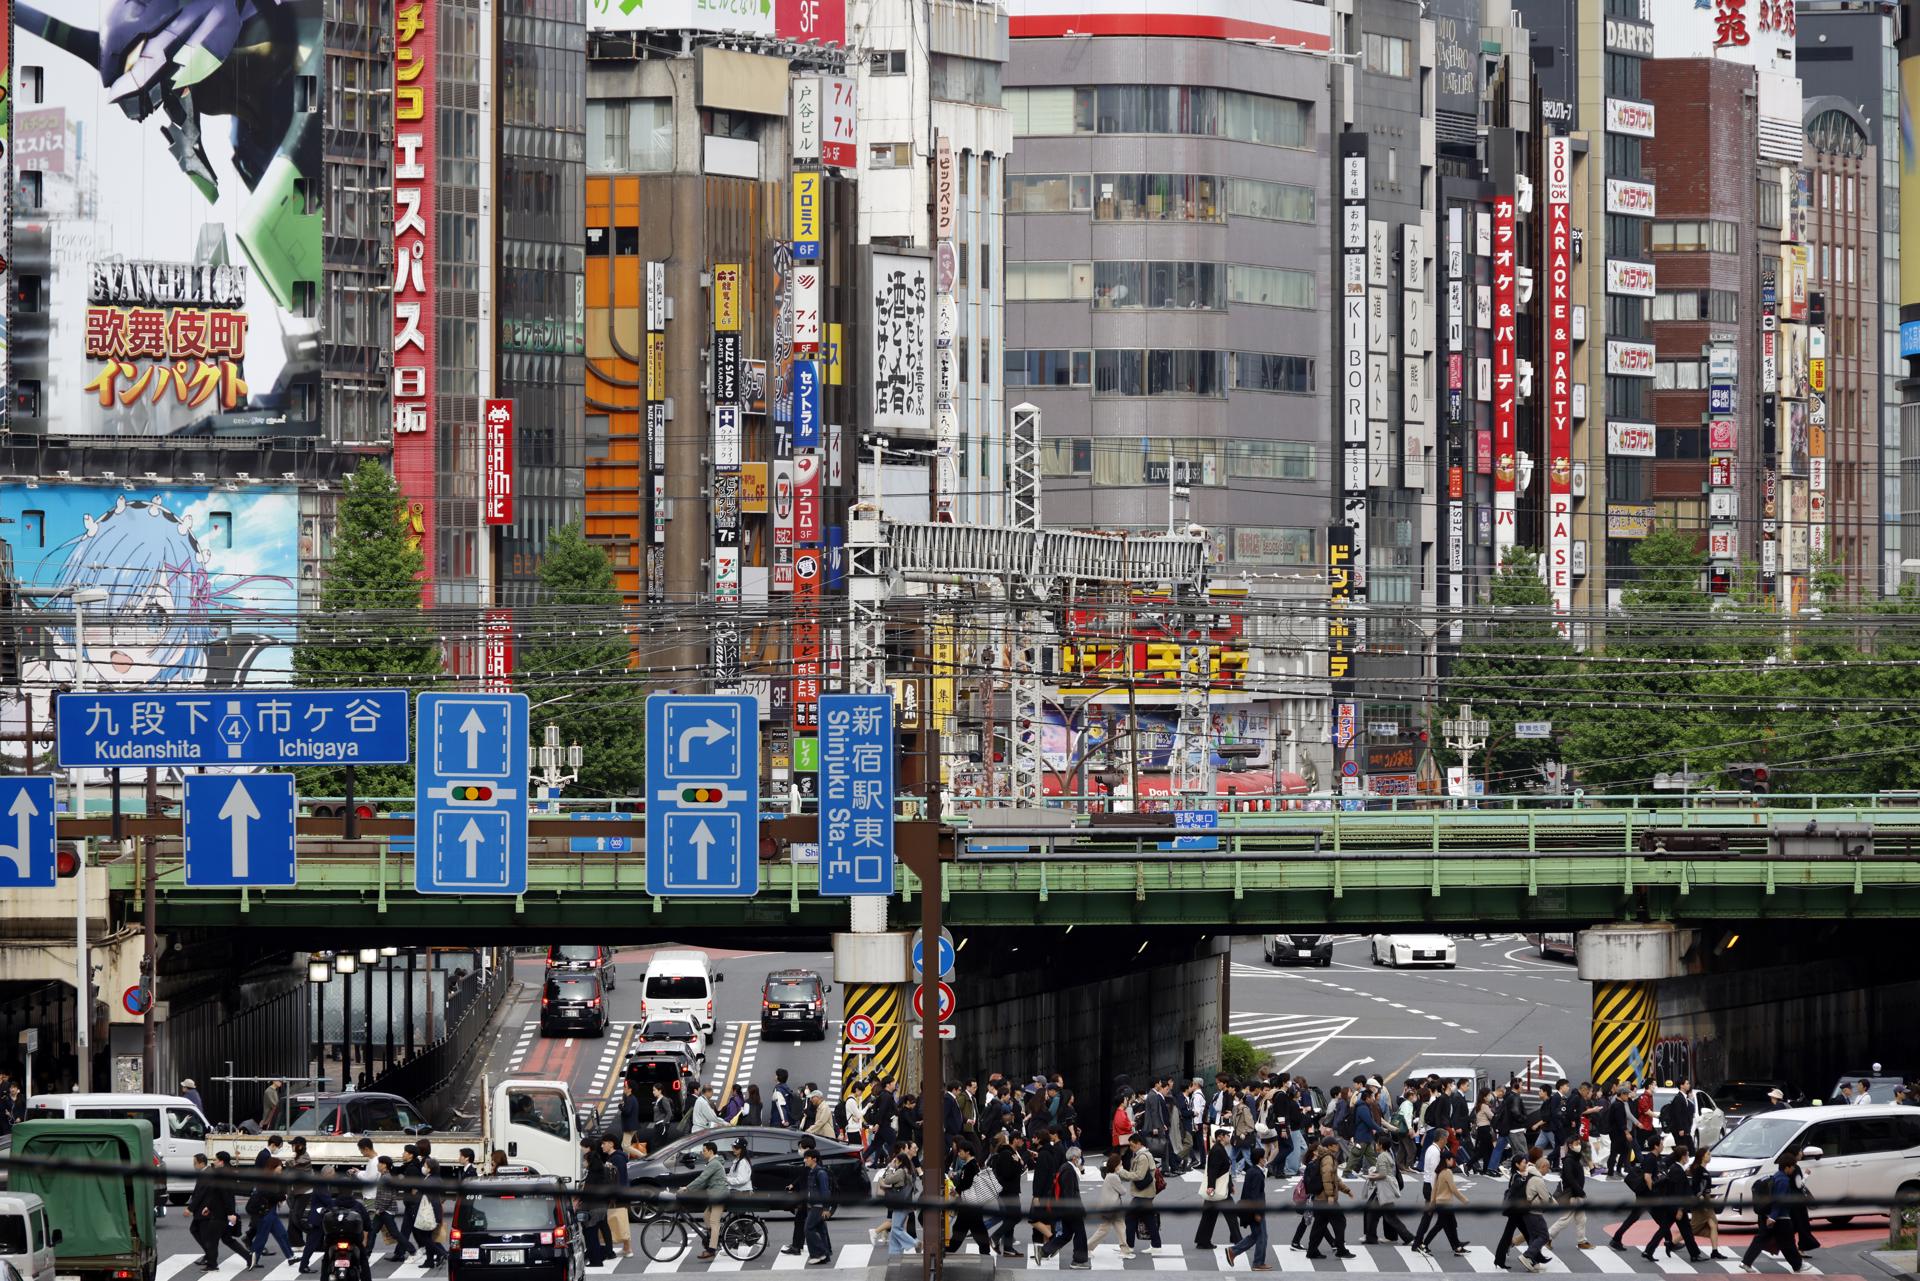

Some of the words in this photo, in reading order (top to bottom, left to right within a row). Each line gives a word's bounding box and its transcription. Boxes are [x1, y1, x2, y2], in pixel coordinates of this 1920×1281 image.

[801, 1, 818, 32] 3F
[1607, 21, 1653, 52] DARTS
[798, 86, 813, 150] 戸谷ビル
[1623, 107, 1648, 130] カラオケ
[1554, 141, 1564, 182] 300
[1350, 161, 1359, 196] 6年4組
[801, 179, 813, 236] プロミス
[1552, 190, 1567, 199] OK
[1623, 188, 1648, 209] カラオケ
[1350, 211, 1359, 243] おかか
[799, 246, 814, 254] 6F
[1554, 205, 1566, 318] KARAOKE
[89, 262, 247, 303] EVANGELION
[1624, 270, 1648, 287] カラオケ
[87, 307, 248, 357] 歌舞伎町
[725, 338, 734, 361] BUZZ
[801, 345, 811, 353] 5F
[1624, 350, 1648, 369] カラオケ
[85, 358, 248, 408] インパクト
[725, 363, 734, 398] STAND
[1349, 302, 1362, 436] KIBORI
[800, 371, 813, 437] セントラル
[1554, 352, 1567, 430] PARTY
[775, 426, 792, 456] 7F
[1624, 429, 1648, 448] カラオケ
[494, 425, 510, 517] GAME
[800, 489, 812, 528] アコム
[718, 530, 735, 541] 7F
[800, 531, 812, 539] 3F
[776, 567, 792, 582] ATM
[773, 687, 787, 707] 3F
[85, 701, 211, 735] 九段下
[228, 721, 240, 739] 4
[95, 741, 201, 759] Kudanshita
[279, 739, 359, 760] Ichigaya
[801, 741, 810, 766] レイク
[828, 710, 850, 799] Shinjuku
[852, 705, 884, 882] 新宿駅東口
